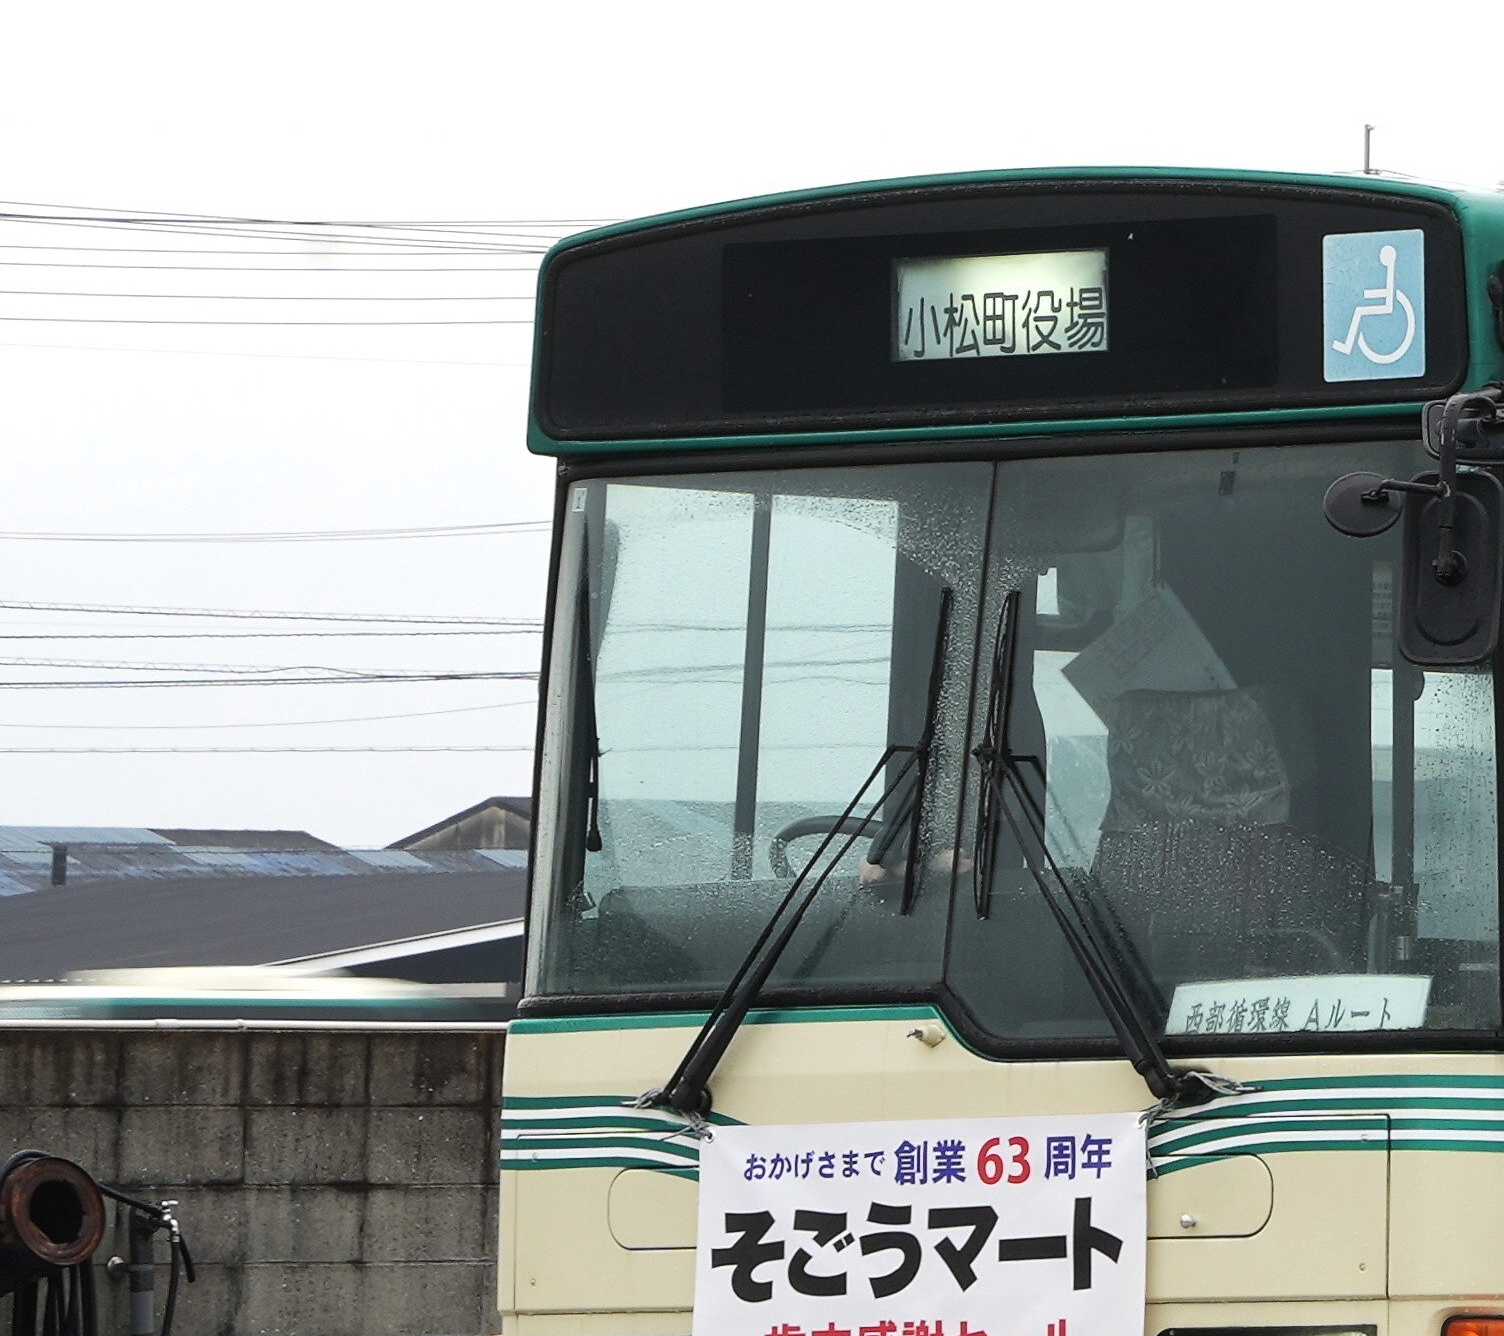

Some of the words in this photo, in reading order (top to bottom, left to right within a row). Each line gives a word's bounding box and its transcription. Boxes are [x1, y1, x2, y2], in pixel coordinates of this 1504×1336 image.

[904, 286, 1106, 358] 小松町役場
[1186, 996, 1292, 1033] 西部循環線
[1303, 997, 1391, 1031] Aルート
[711, 1197, 1124, 1303] そごうマート
